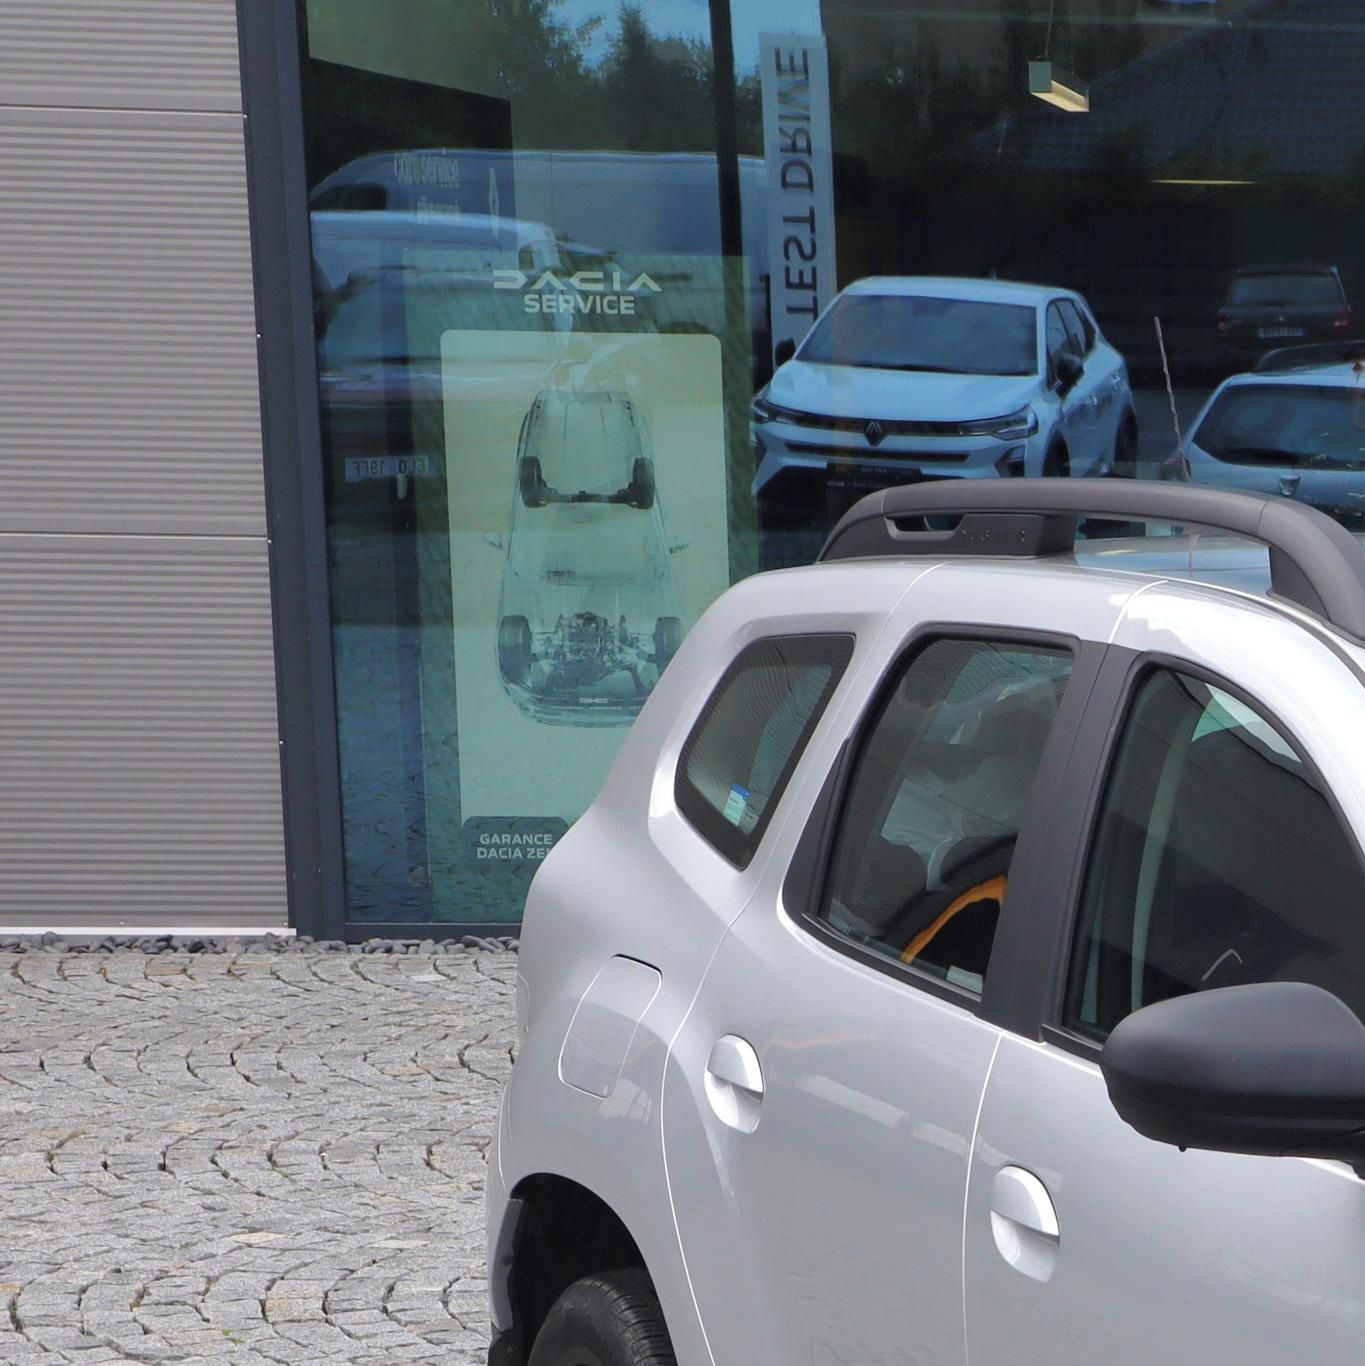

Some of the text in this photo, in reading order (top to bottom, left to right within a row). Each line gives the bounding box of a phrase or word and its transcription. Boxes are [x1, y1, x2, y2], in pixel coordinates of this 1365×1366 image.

[493, 269, 663, 291] DACIA
[524, 294, 635, 314] SERVICE
[480, 833, 553, 845] GARANCE
[477, 847, 550, 859] DACIA ZE
